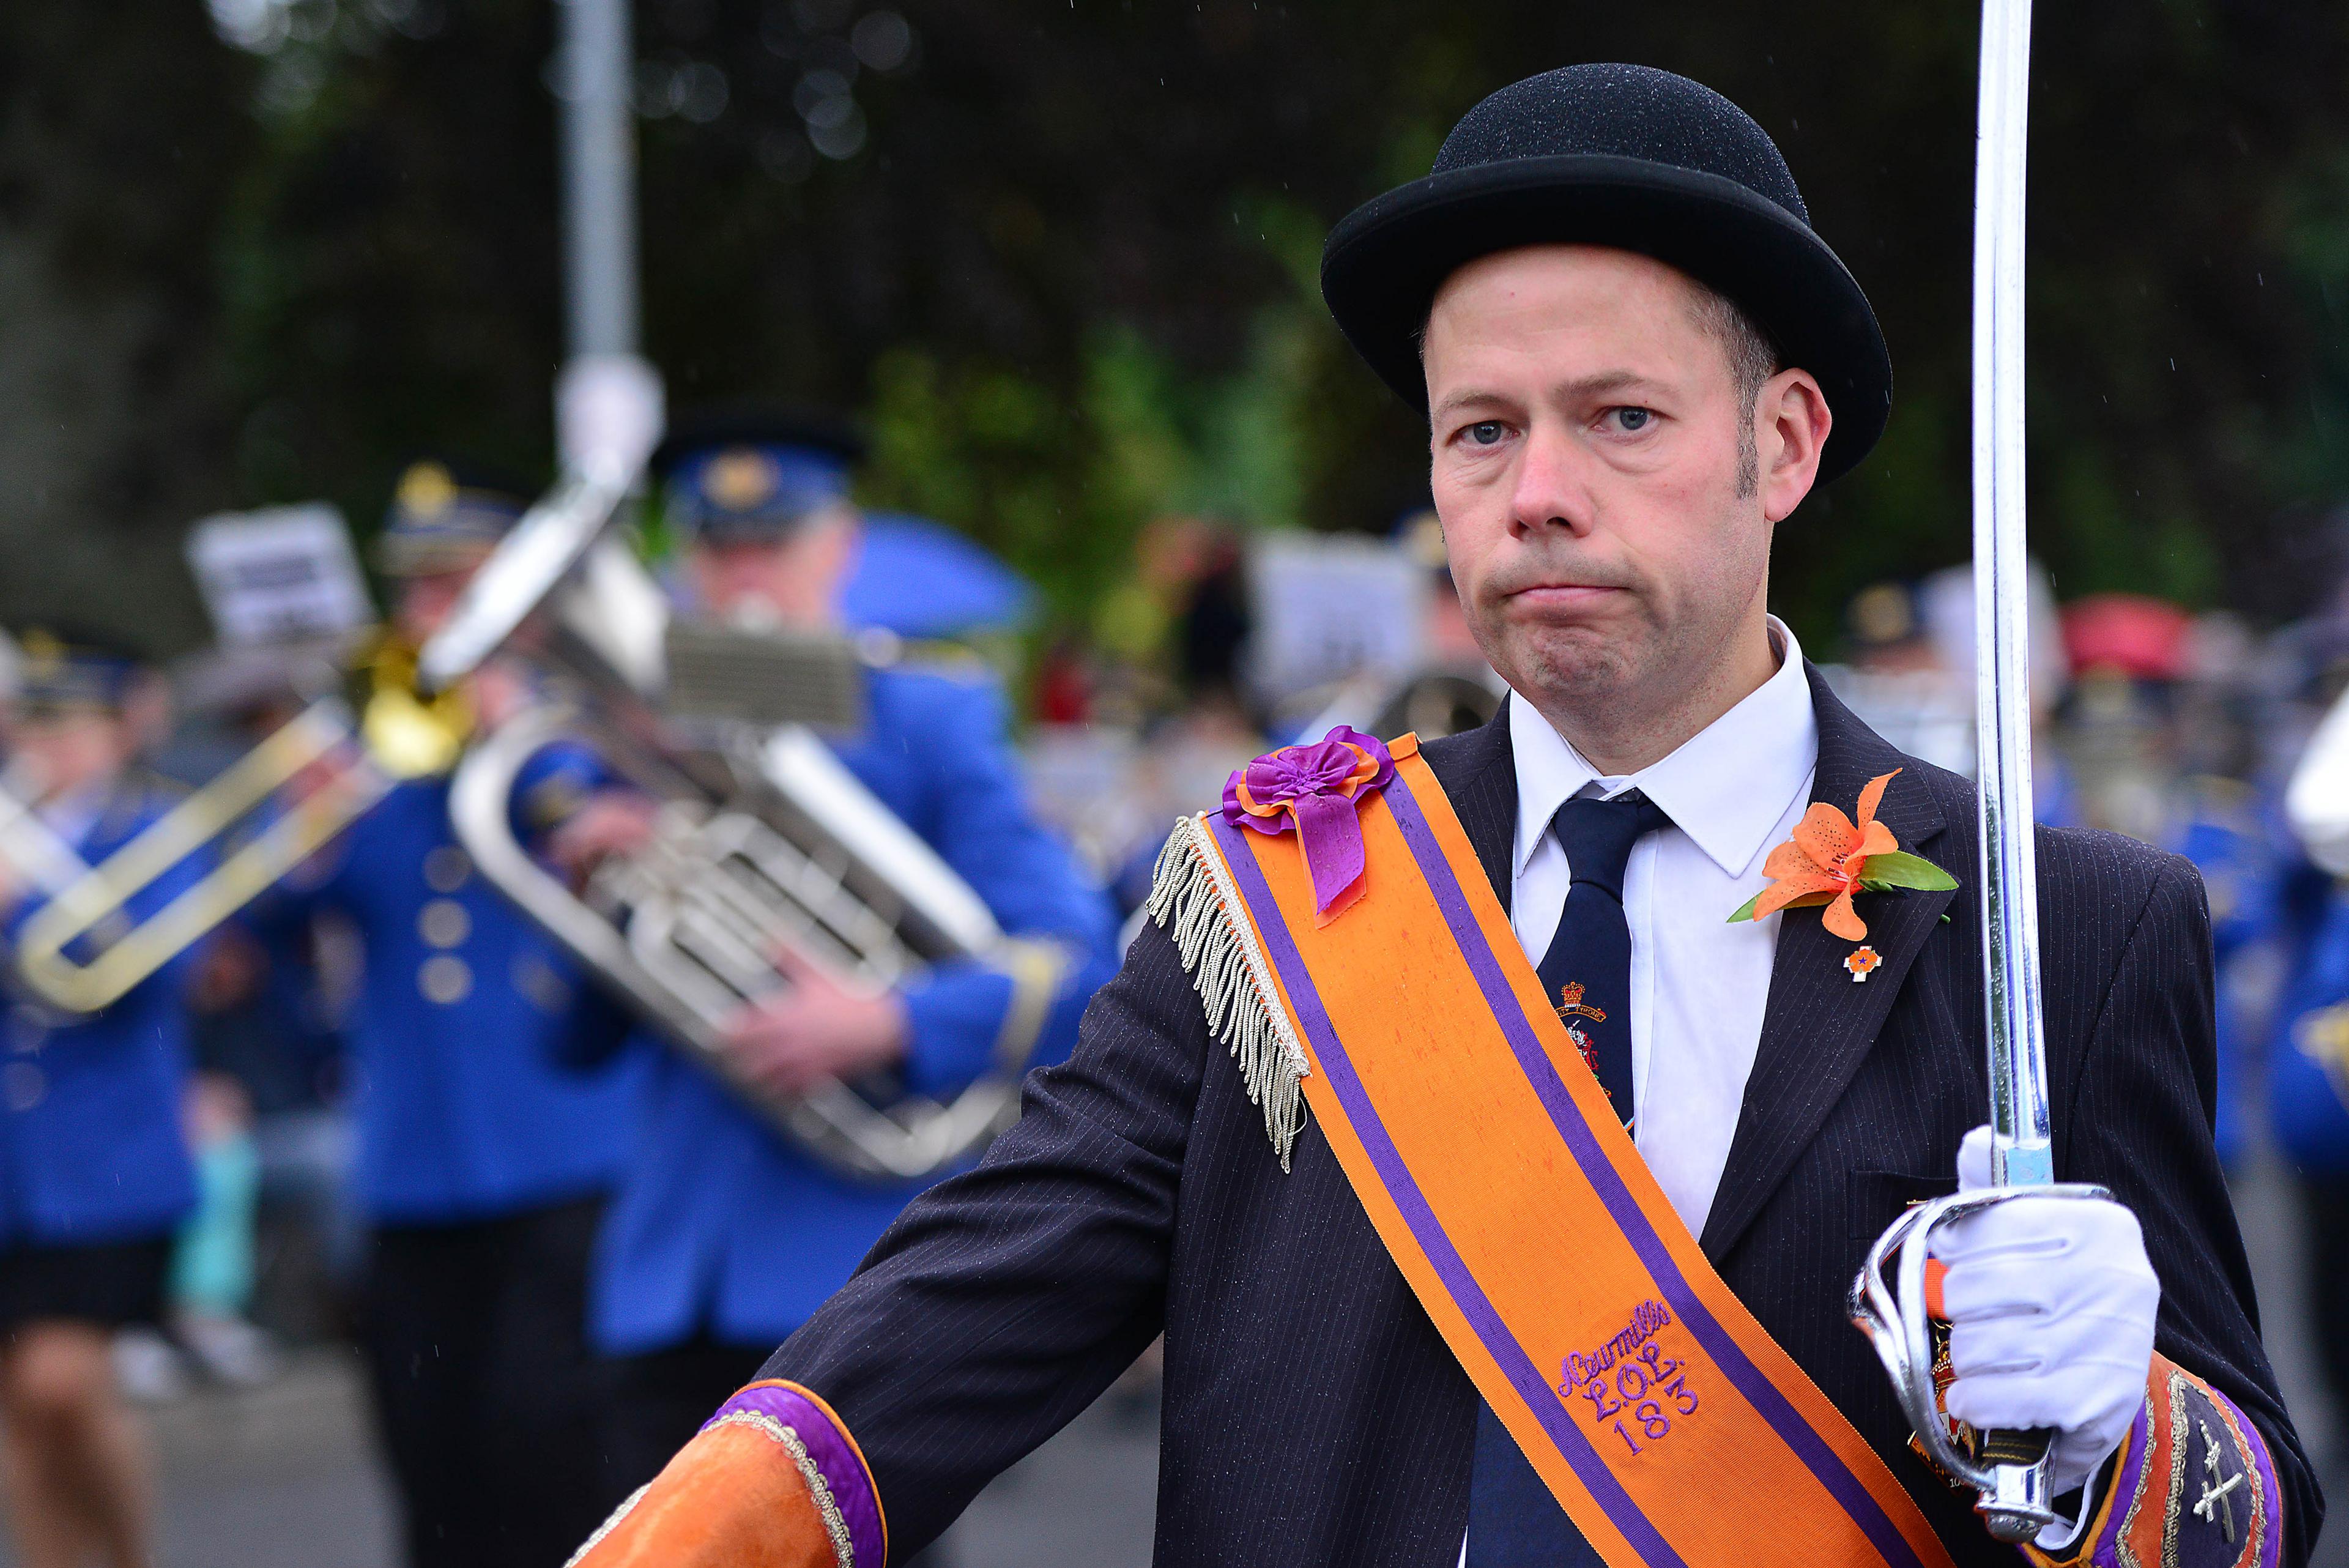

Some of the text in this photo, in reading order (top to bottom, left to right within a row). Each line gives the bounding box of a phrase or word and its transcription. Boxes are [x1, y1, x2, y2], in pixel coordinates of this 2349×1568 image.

[1575, 1006, 1601, 1020] TYRONE
[1559, 1299, 1671, 1397] Newmills
[1614, 1374, 1699, 1456] 183
